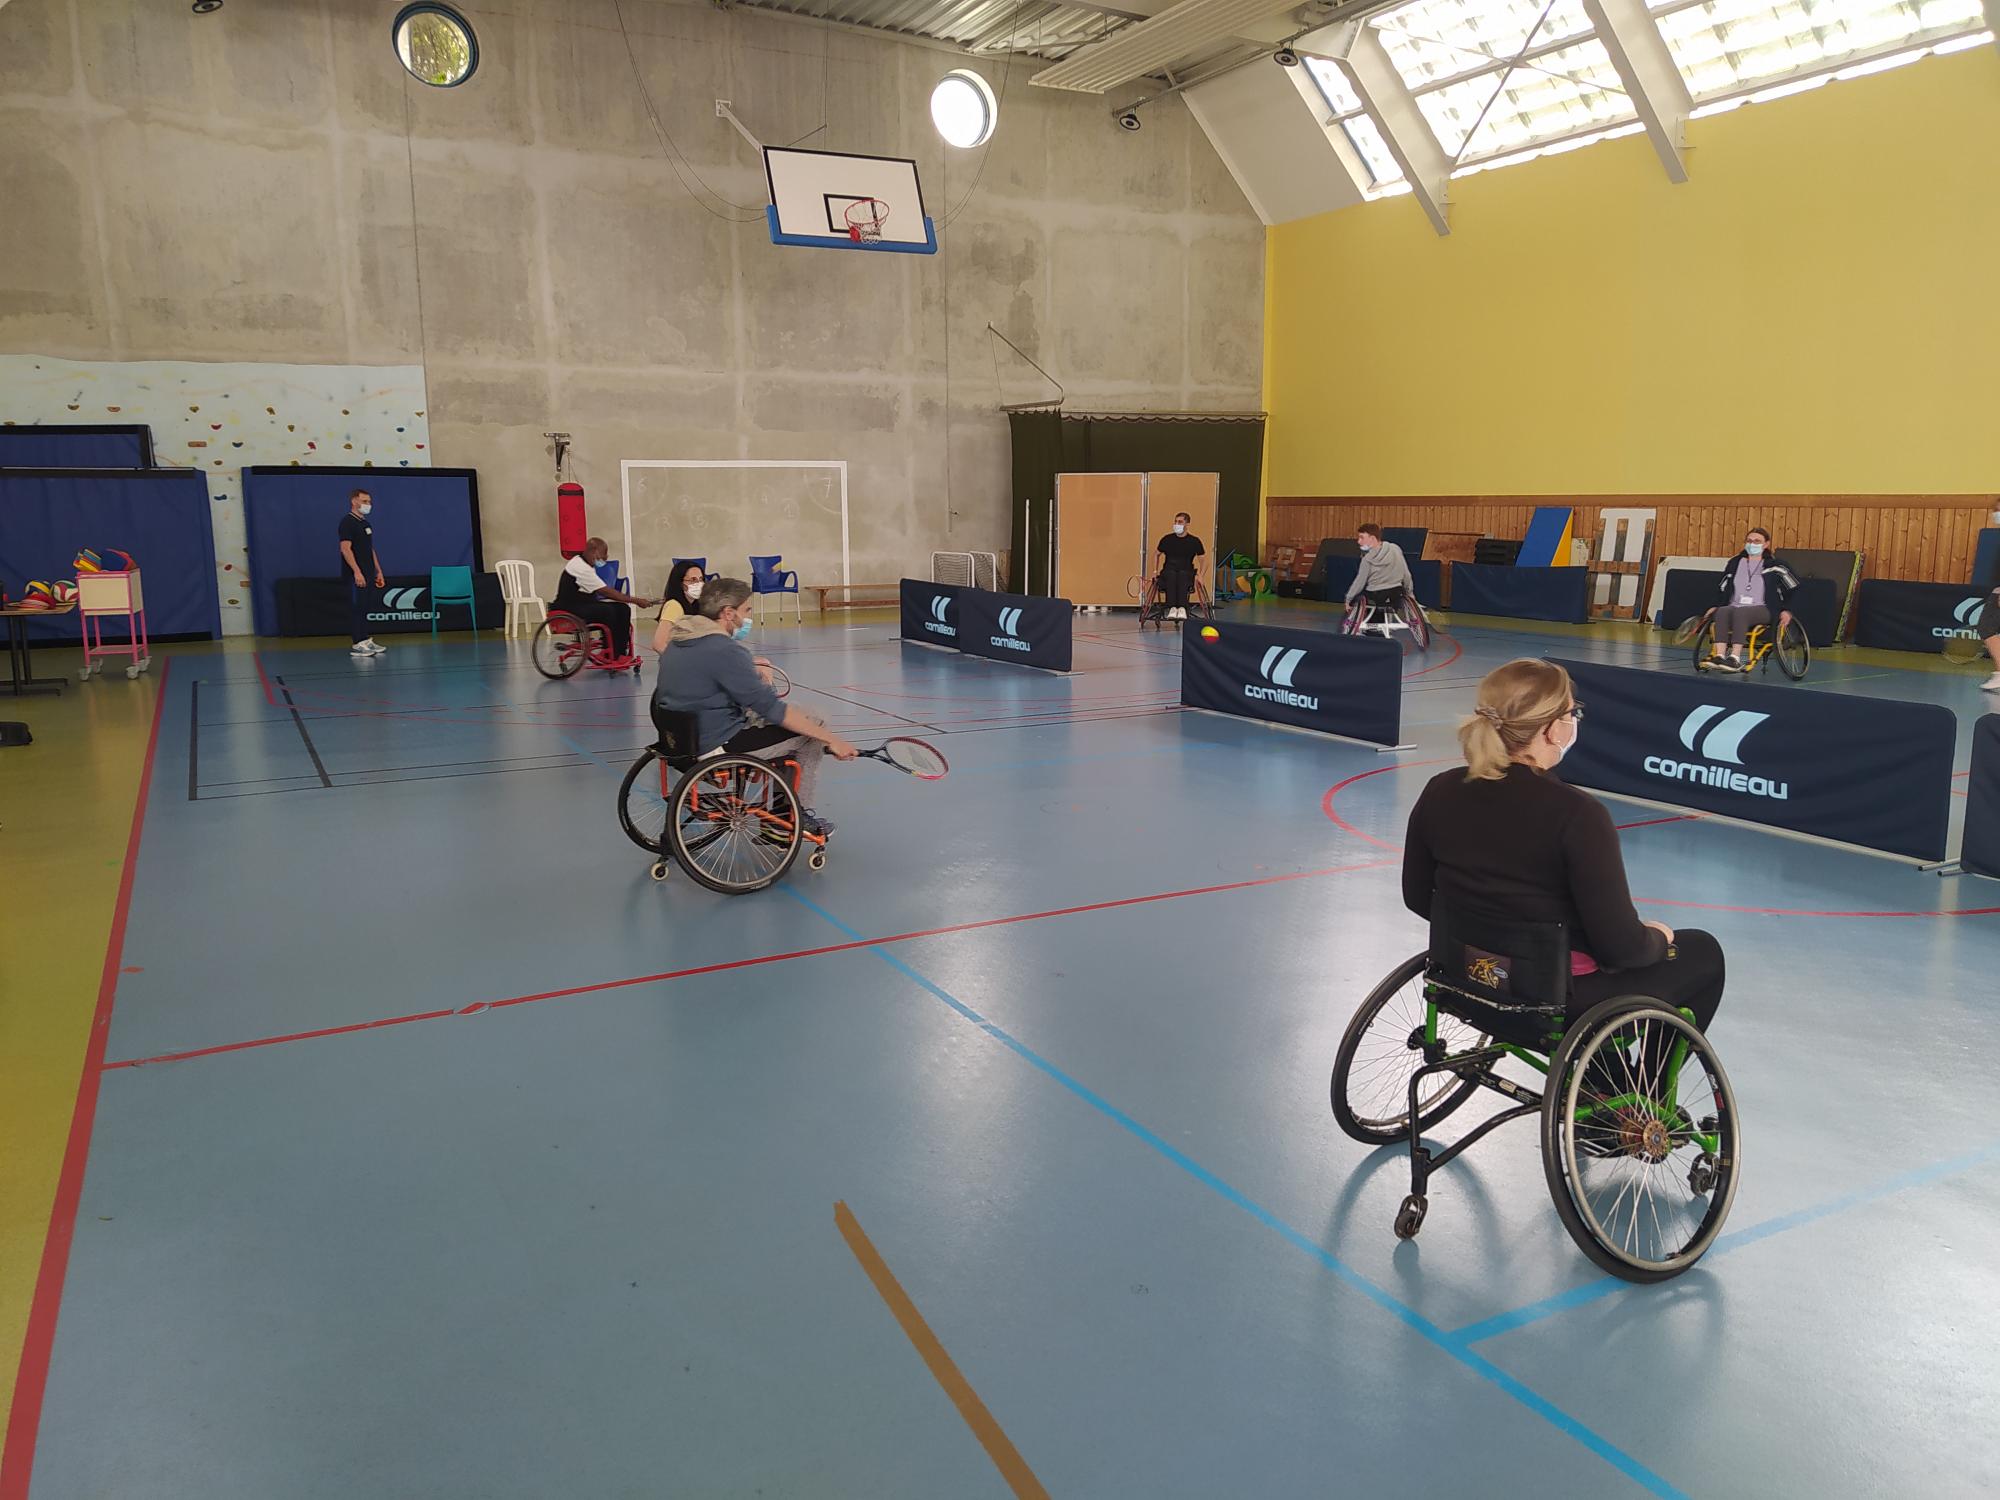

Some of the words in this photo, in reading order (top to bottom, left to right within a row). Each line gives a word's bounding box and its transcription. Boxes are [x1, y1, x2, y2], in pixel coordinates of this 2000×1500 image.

[366, 611, 441, 621] cornilleau
[924, 621, 957, 637] cornilleau
[1931, 627, 1981, 640] corni
[990, 636, 1031, 652] cornilleau
[1244, 684, 1319, 710] cornilleau
[1643, 755, 1789, 800] cornilleau
